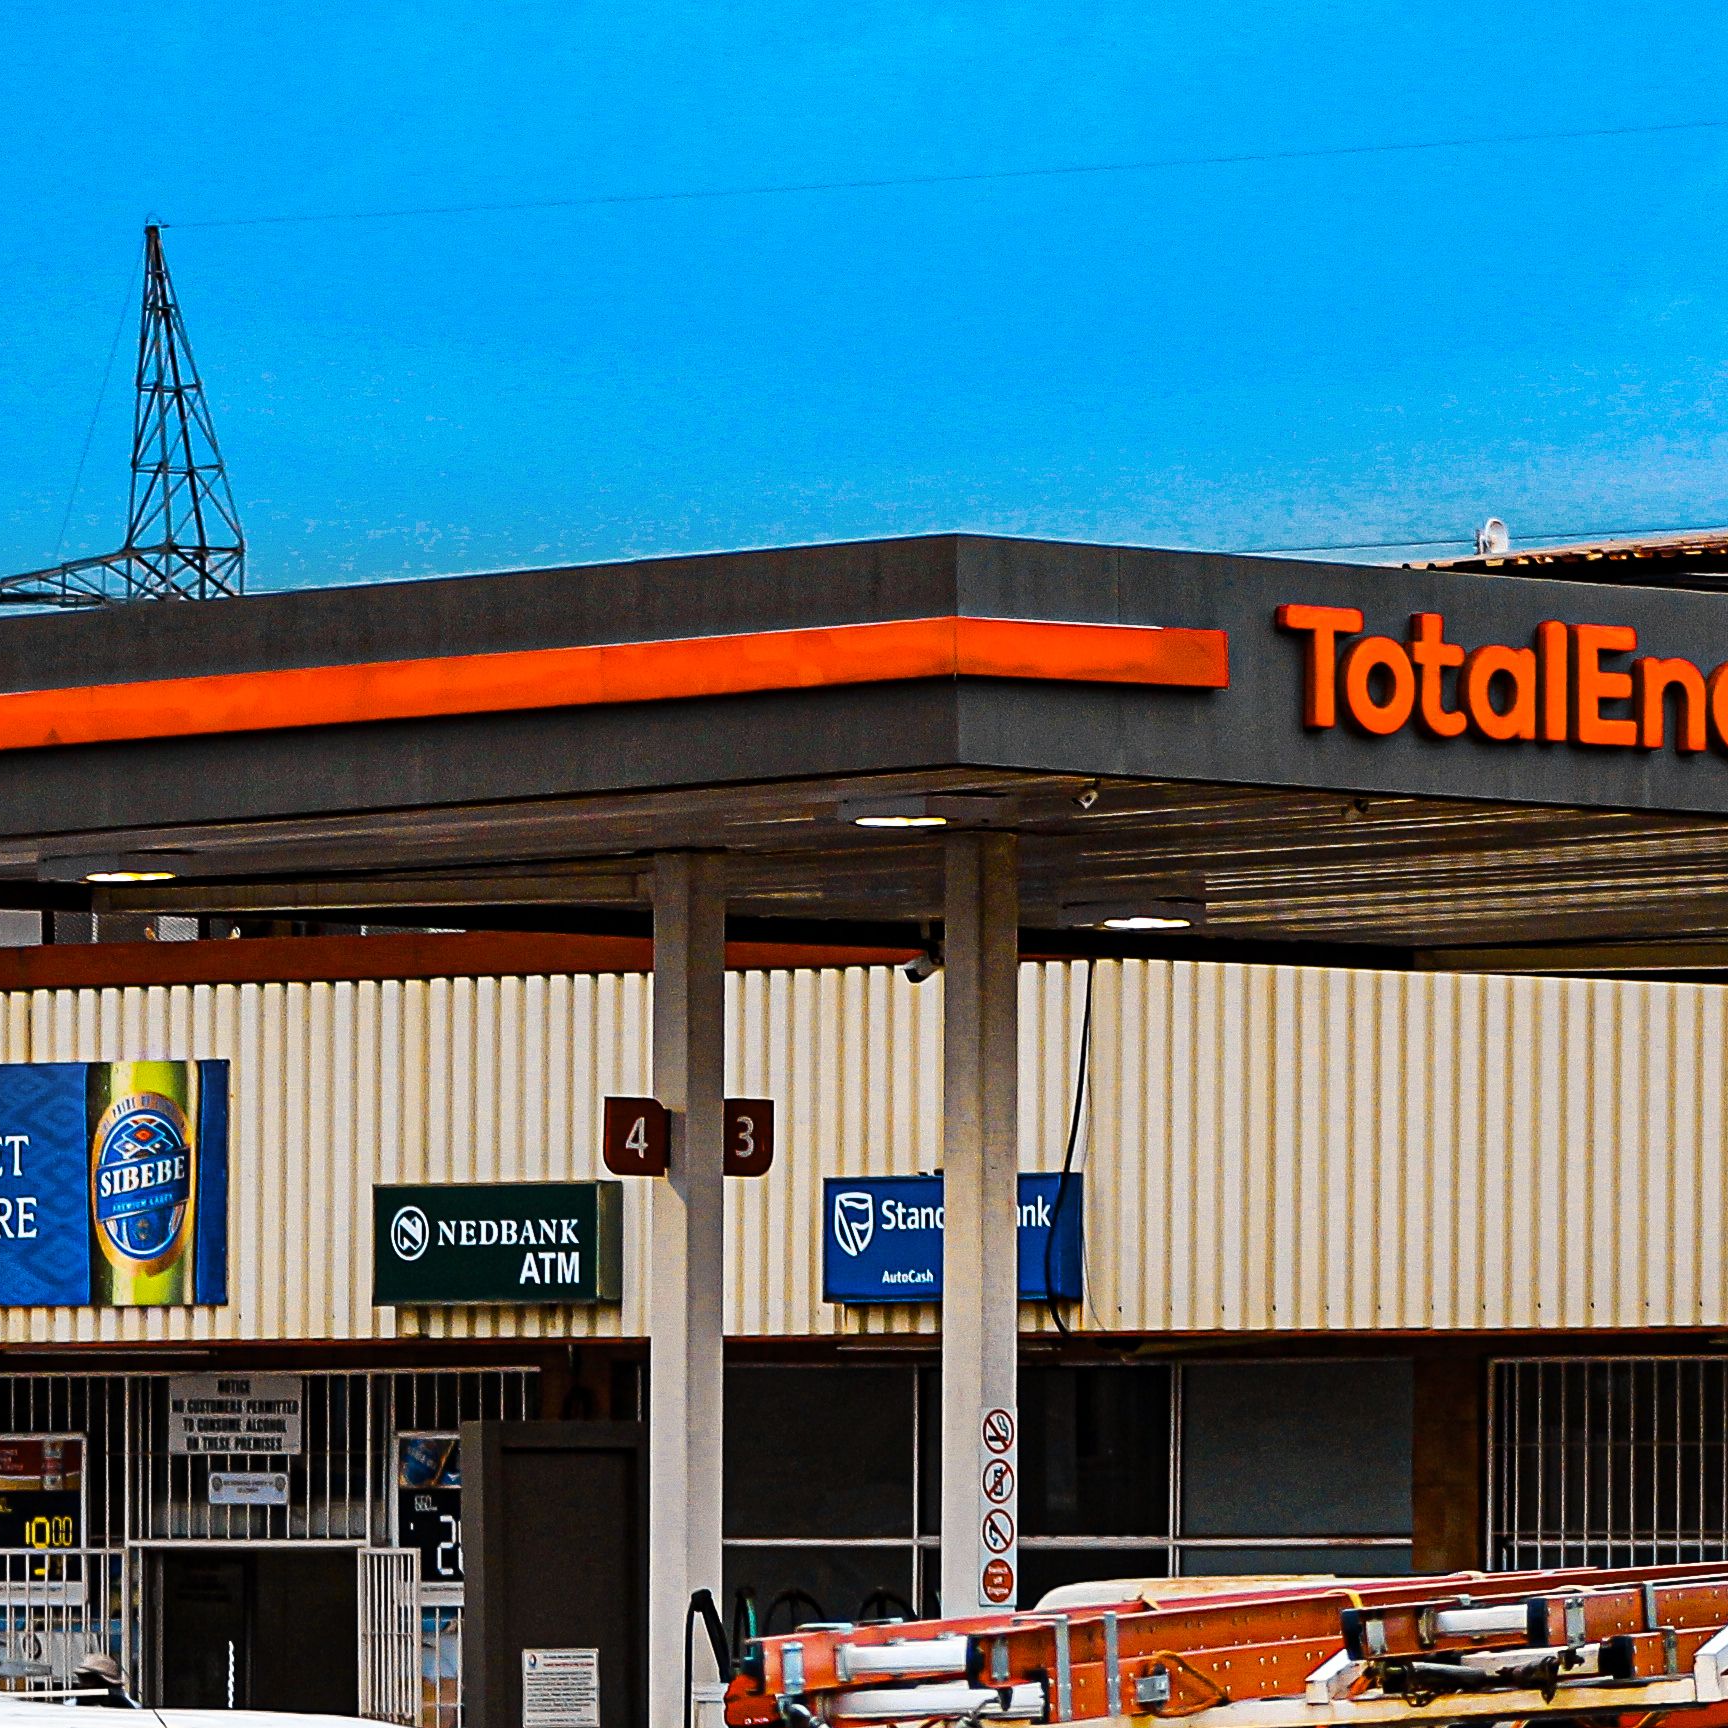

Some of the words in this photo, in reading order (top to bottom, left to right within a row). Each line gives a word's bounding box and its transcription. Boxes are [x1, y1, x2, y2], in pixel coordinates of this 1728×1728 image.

[625, 1116, 648, 1159] 4
[736, 1116, 754, 1158] 3
[100, 1156, 186, 1198] SIBEBE
[1016, 1195, 1052, 1228] nk
[437, 1218, 580, 1246] NEDBANK
[519, 1252, 580, 1284] ATM
[882, 1269, 934, 1284] AutoCash
